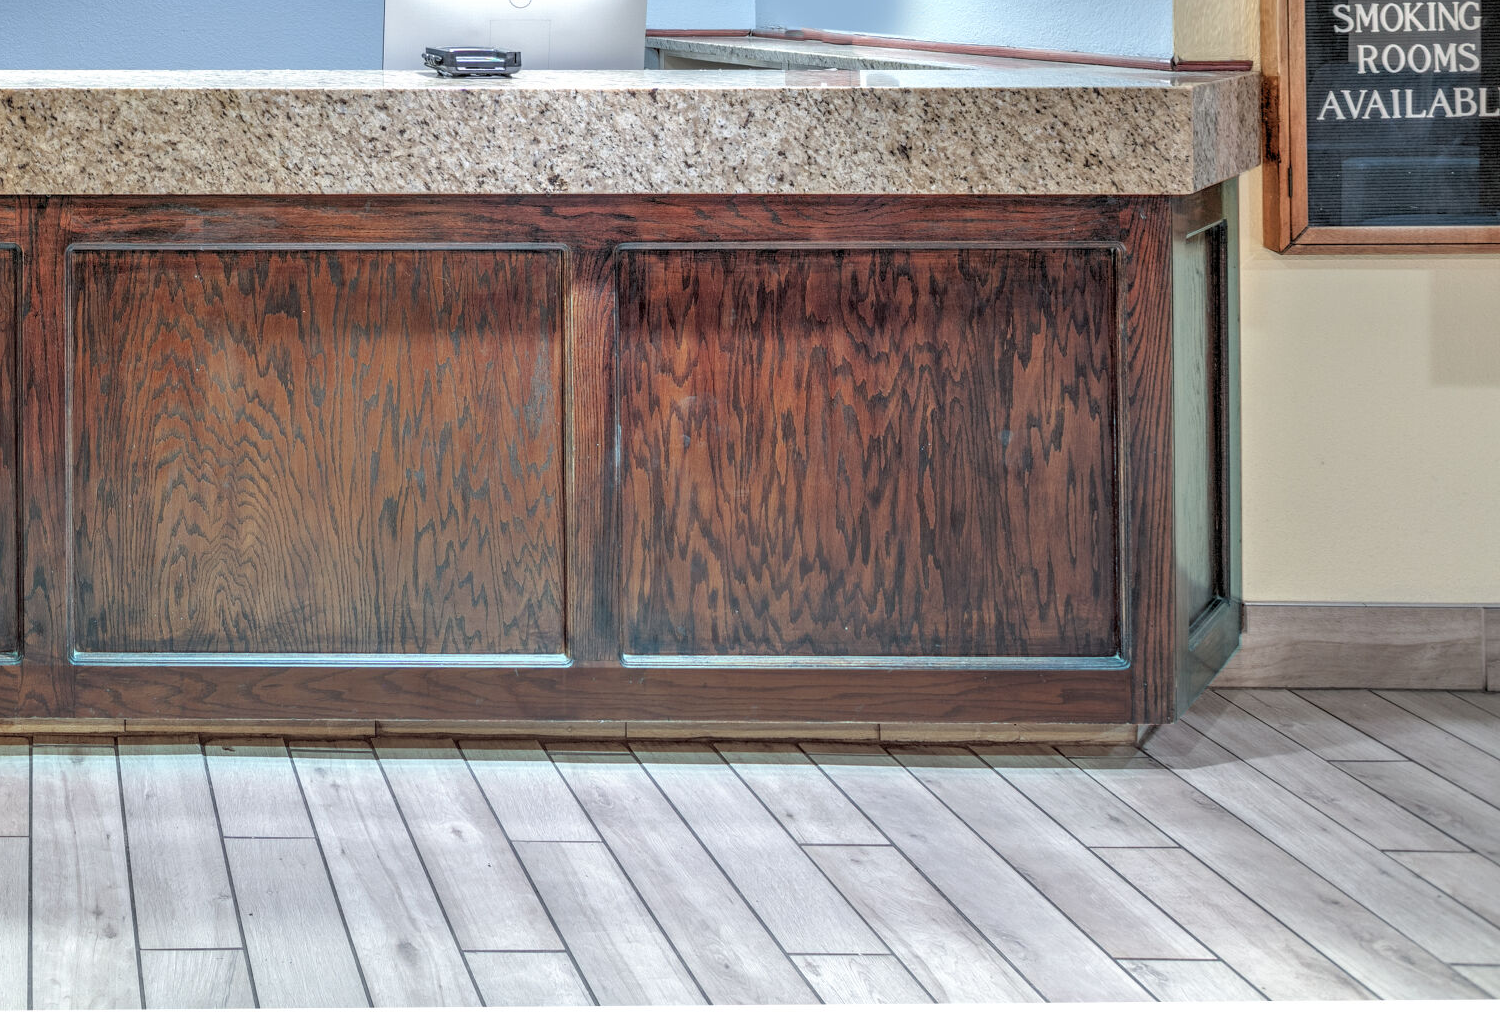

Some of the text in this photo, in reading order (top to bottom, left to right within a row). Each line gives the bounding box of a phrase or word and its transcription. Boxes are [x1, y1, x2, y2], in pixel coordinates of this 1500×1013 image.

[1333, 1, 1482, 33] SMOKING
[1357, 43, 1480, 74] ROOMS
[1316, 87, 1500, 120] AVAILABL
